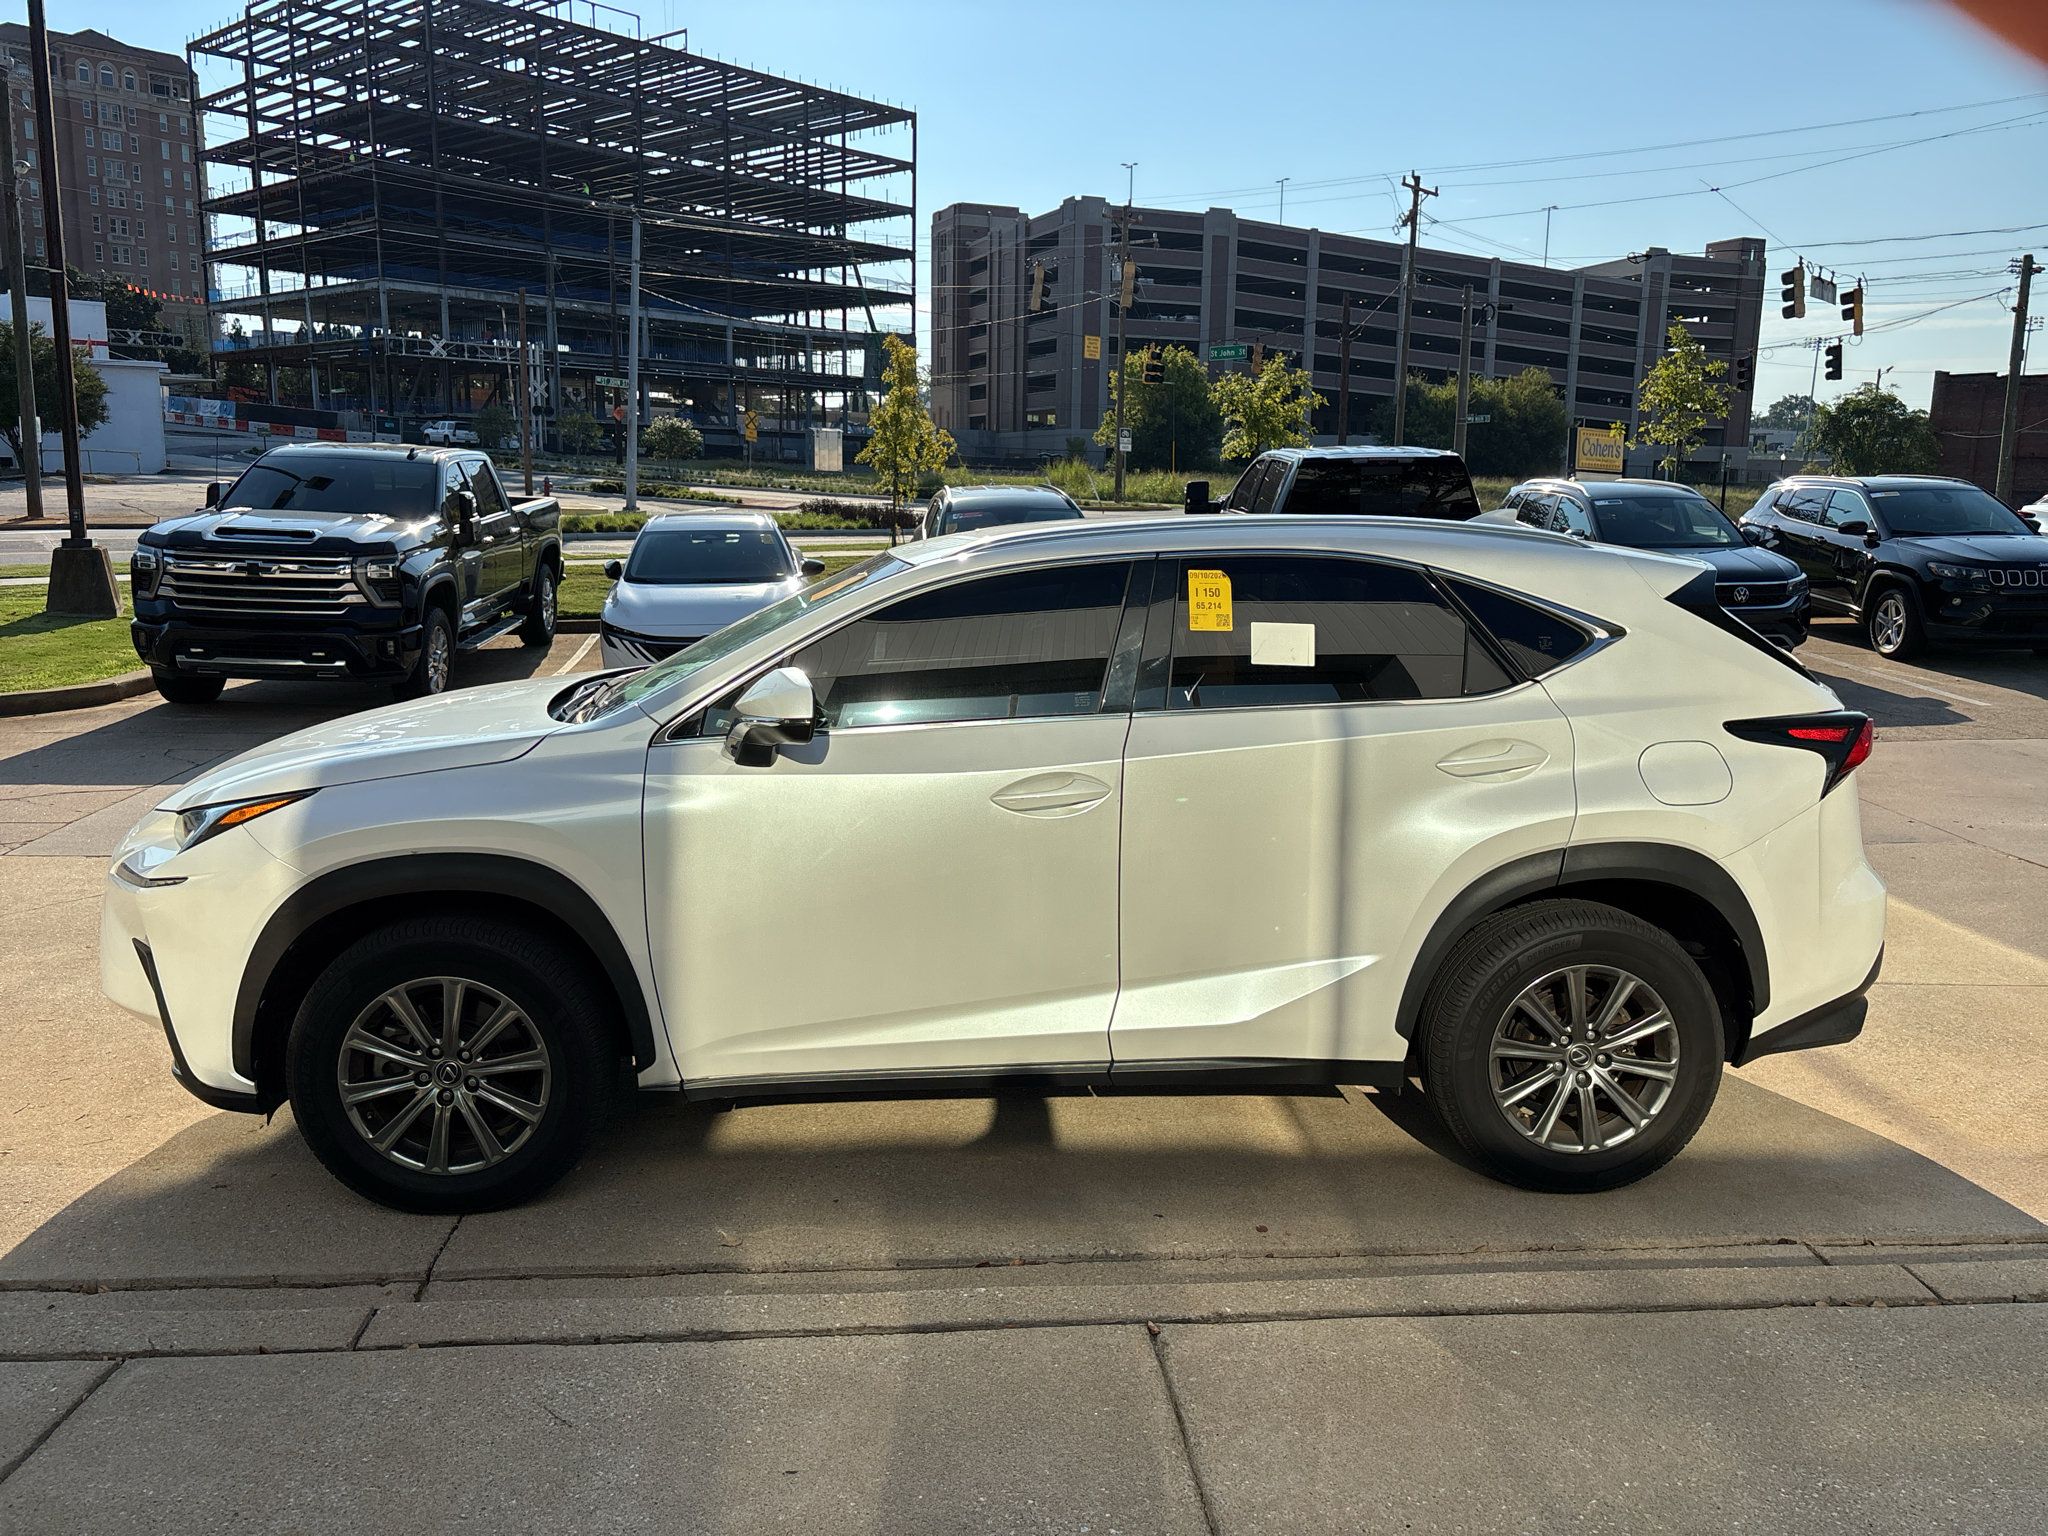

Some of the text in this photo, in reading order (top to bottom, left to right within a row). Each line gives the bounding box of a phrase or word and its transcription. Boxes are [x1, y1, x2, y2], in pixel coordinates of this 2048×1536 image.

[1211, 350, 1218, 358] St
[1239, 348, 1246, 356] St
[1582, 438, 1621, 459] Cohen's
[1189, 571, 1227, 580] 09/10/202
[1203, 587, 1221, 598] 150
[1196, 601, 1222, 611] 65,214
